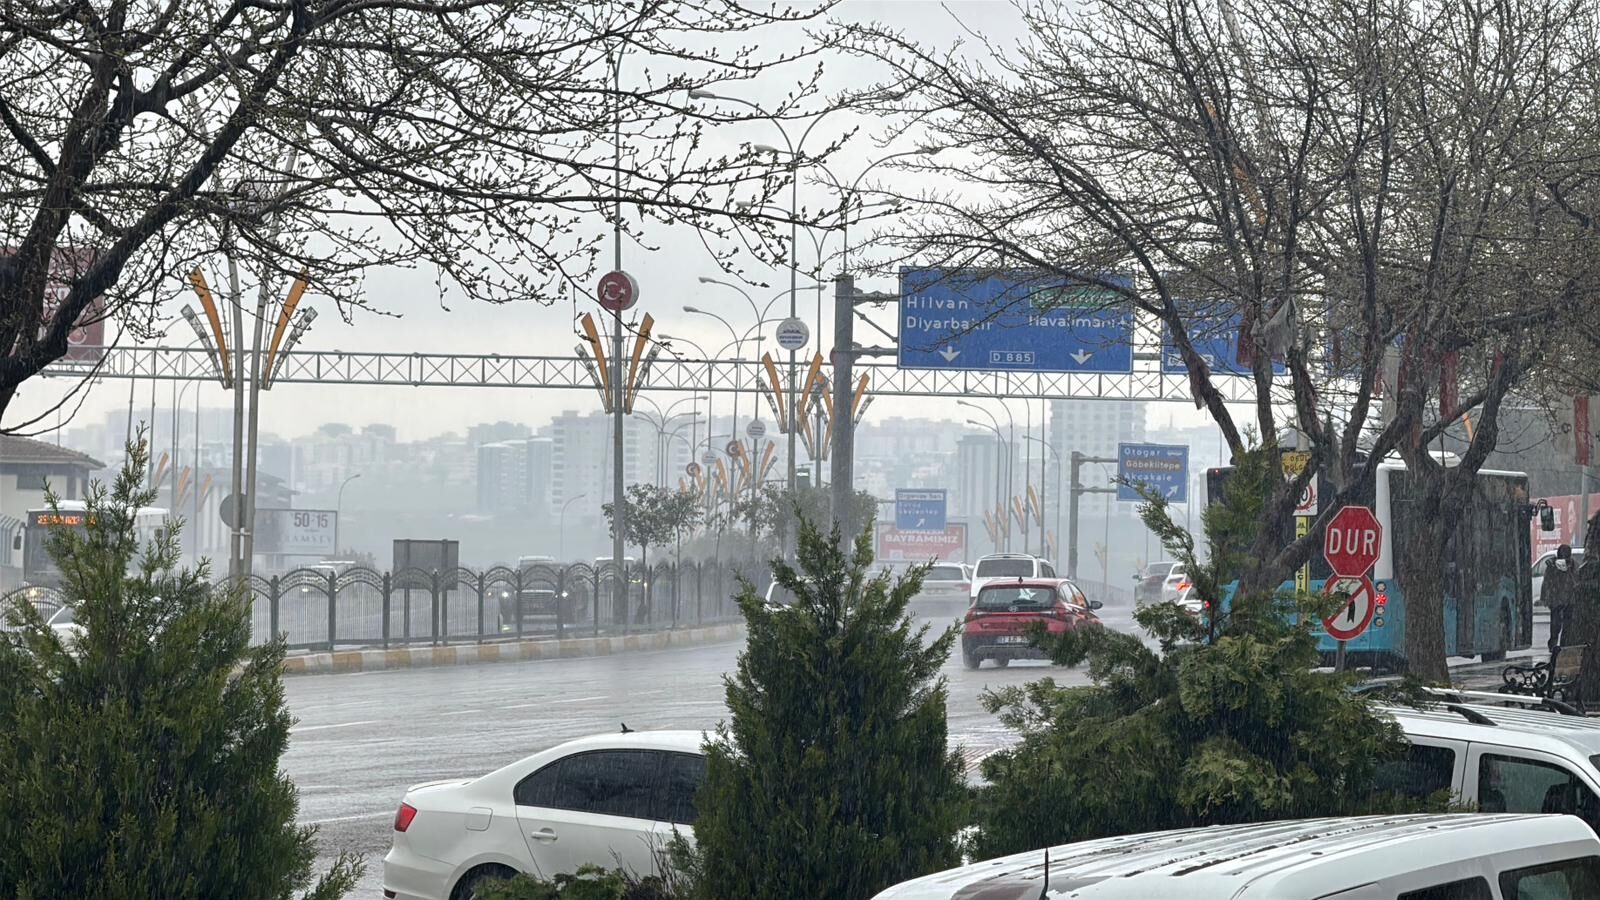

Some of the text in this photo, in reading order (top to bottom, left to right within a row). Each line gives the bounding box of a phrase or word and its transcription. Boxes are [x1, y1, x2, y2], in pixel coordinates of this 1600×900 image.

[907, 296, 968, 309] Hilvan
[992, 352, 1031, 362] D 885
[1124, 447, 1160, 457] Otogar
[885, 534, 959, 544] BAYRAMIMIZ
[1328, 528, 1376, 556] DUR
